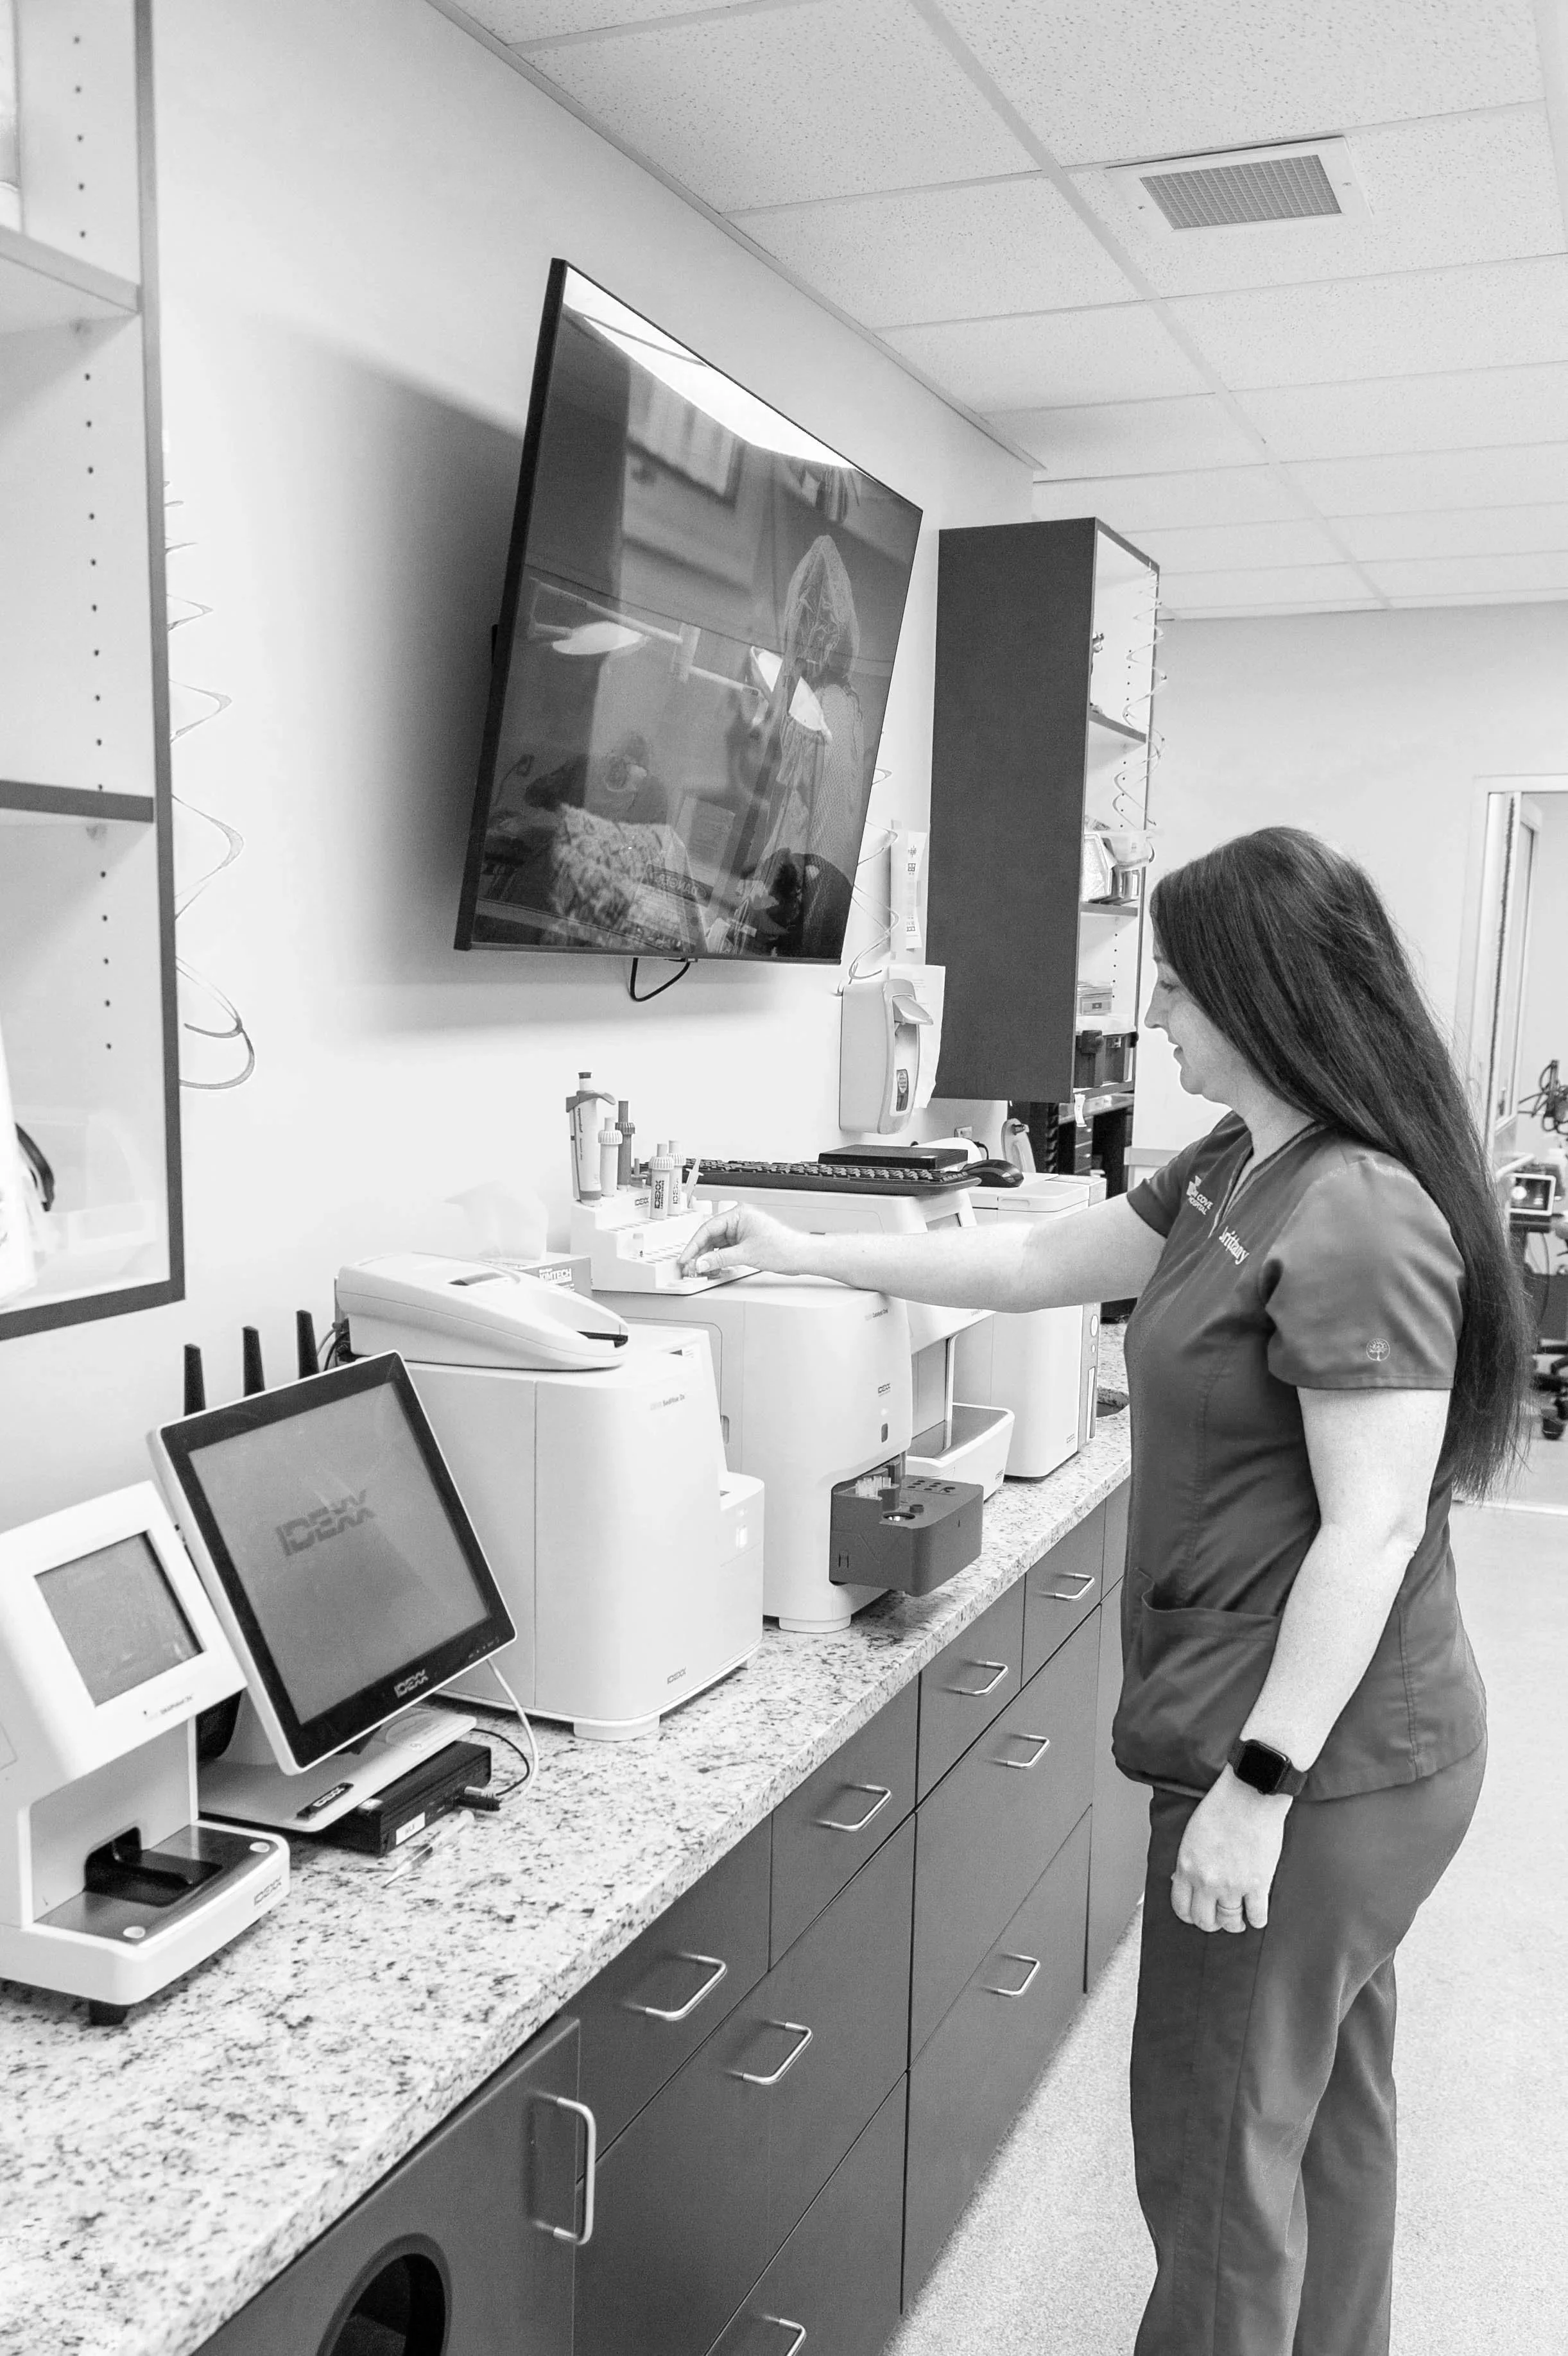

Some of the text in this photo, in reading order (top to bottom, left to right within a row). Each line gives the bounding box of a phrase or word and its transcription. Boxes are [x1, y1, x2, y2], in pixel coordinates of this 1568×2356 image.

[1196, 1194, 1213, 1210] COVE
[275, 1489, 375, 1557] IDEXX
[393, 1669, 429, 1699] IDEXX
[667, 1666, 687, 1685] IDEXX
[313, 1787, 345, 1807] IDEXX
[254, 1875, 282, 1906] IDEXX
